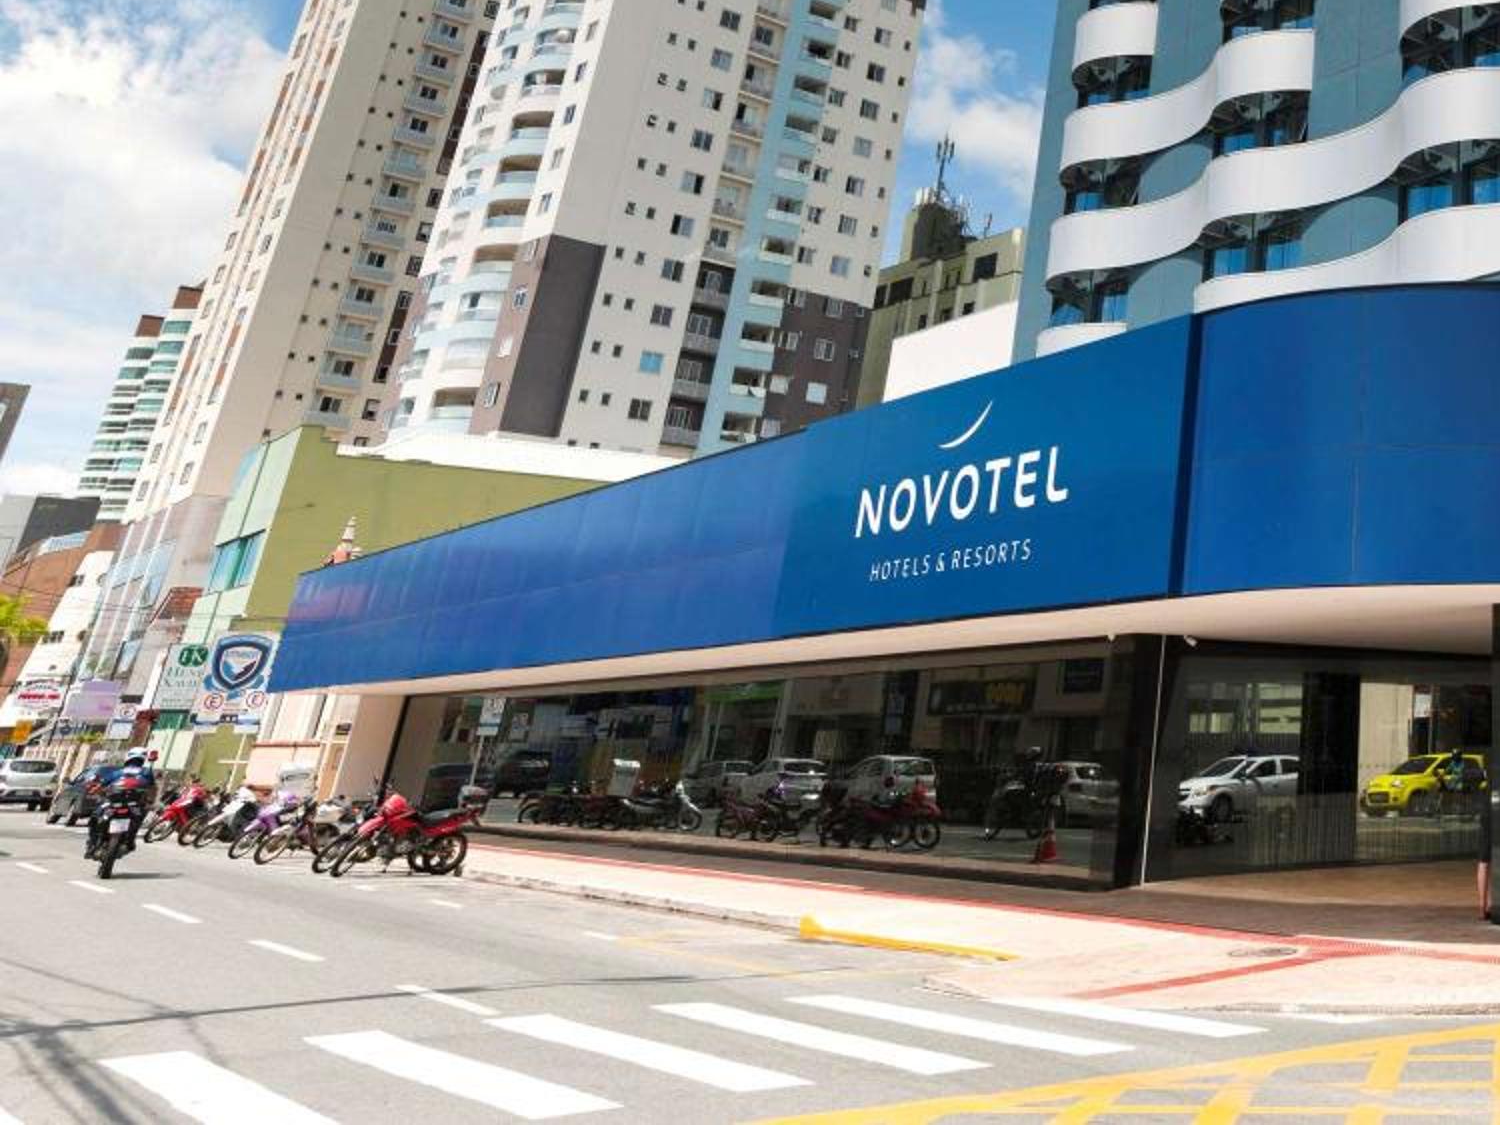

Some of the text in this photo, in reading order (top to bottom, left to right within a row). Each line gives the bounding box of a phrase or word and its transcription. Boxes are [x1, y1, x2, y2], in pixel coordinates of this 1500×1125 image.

[854, 445, 1069, 538] NOVOTEL
[869, 538, 1033, 582] HOTELS & RESORTS
